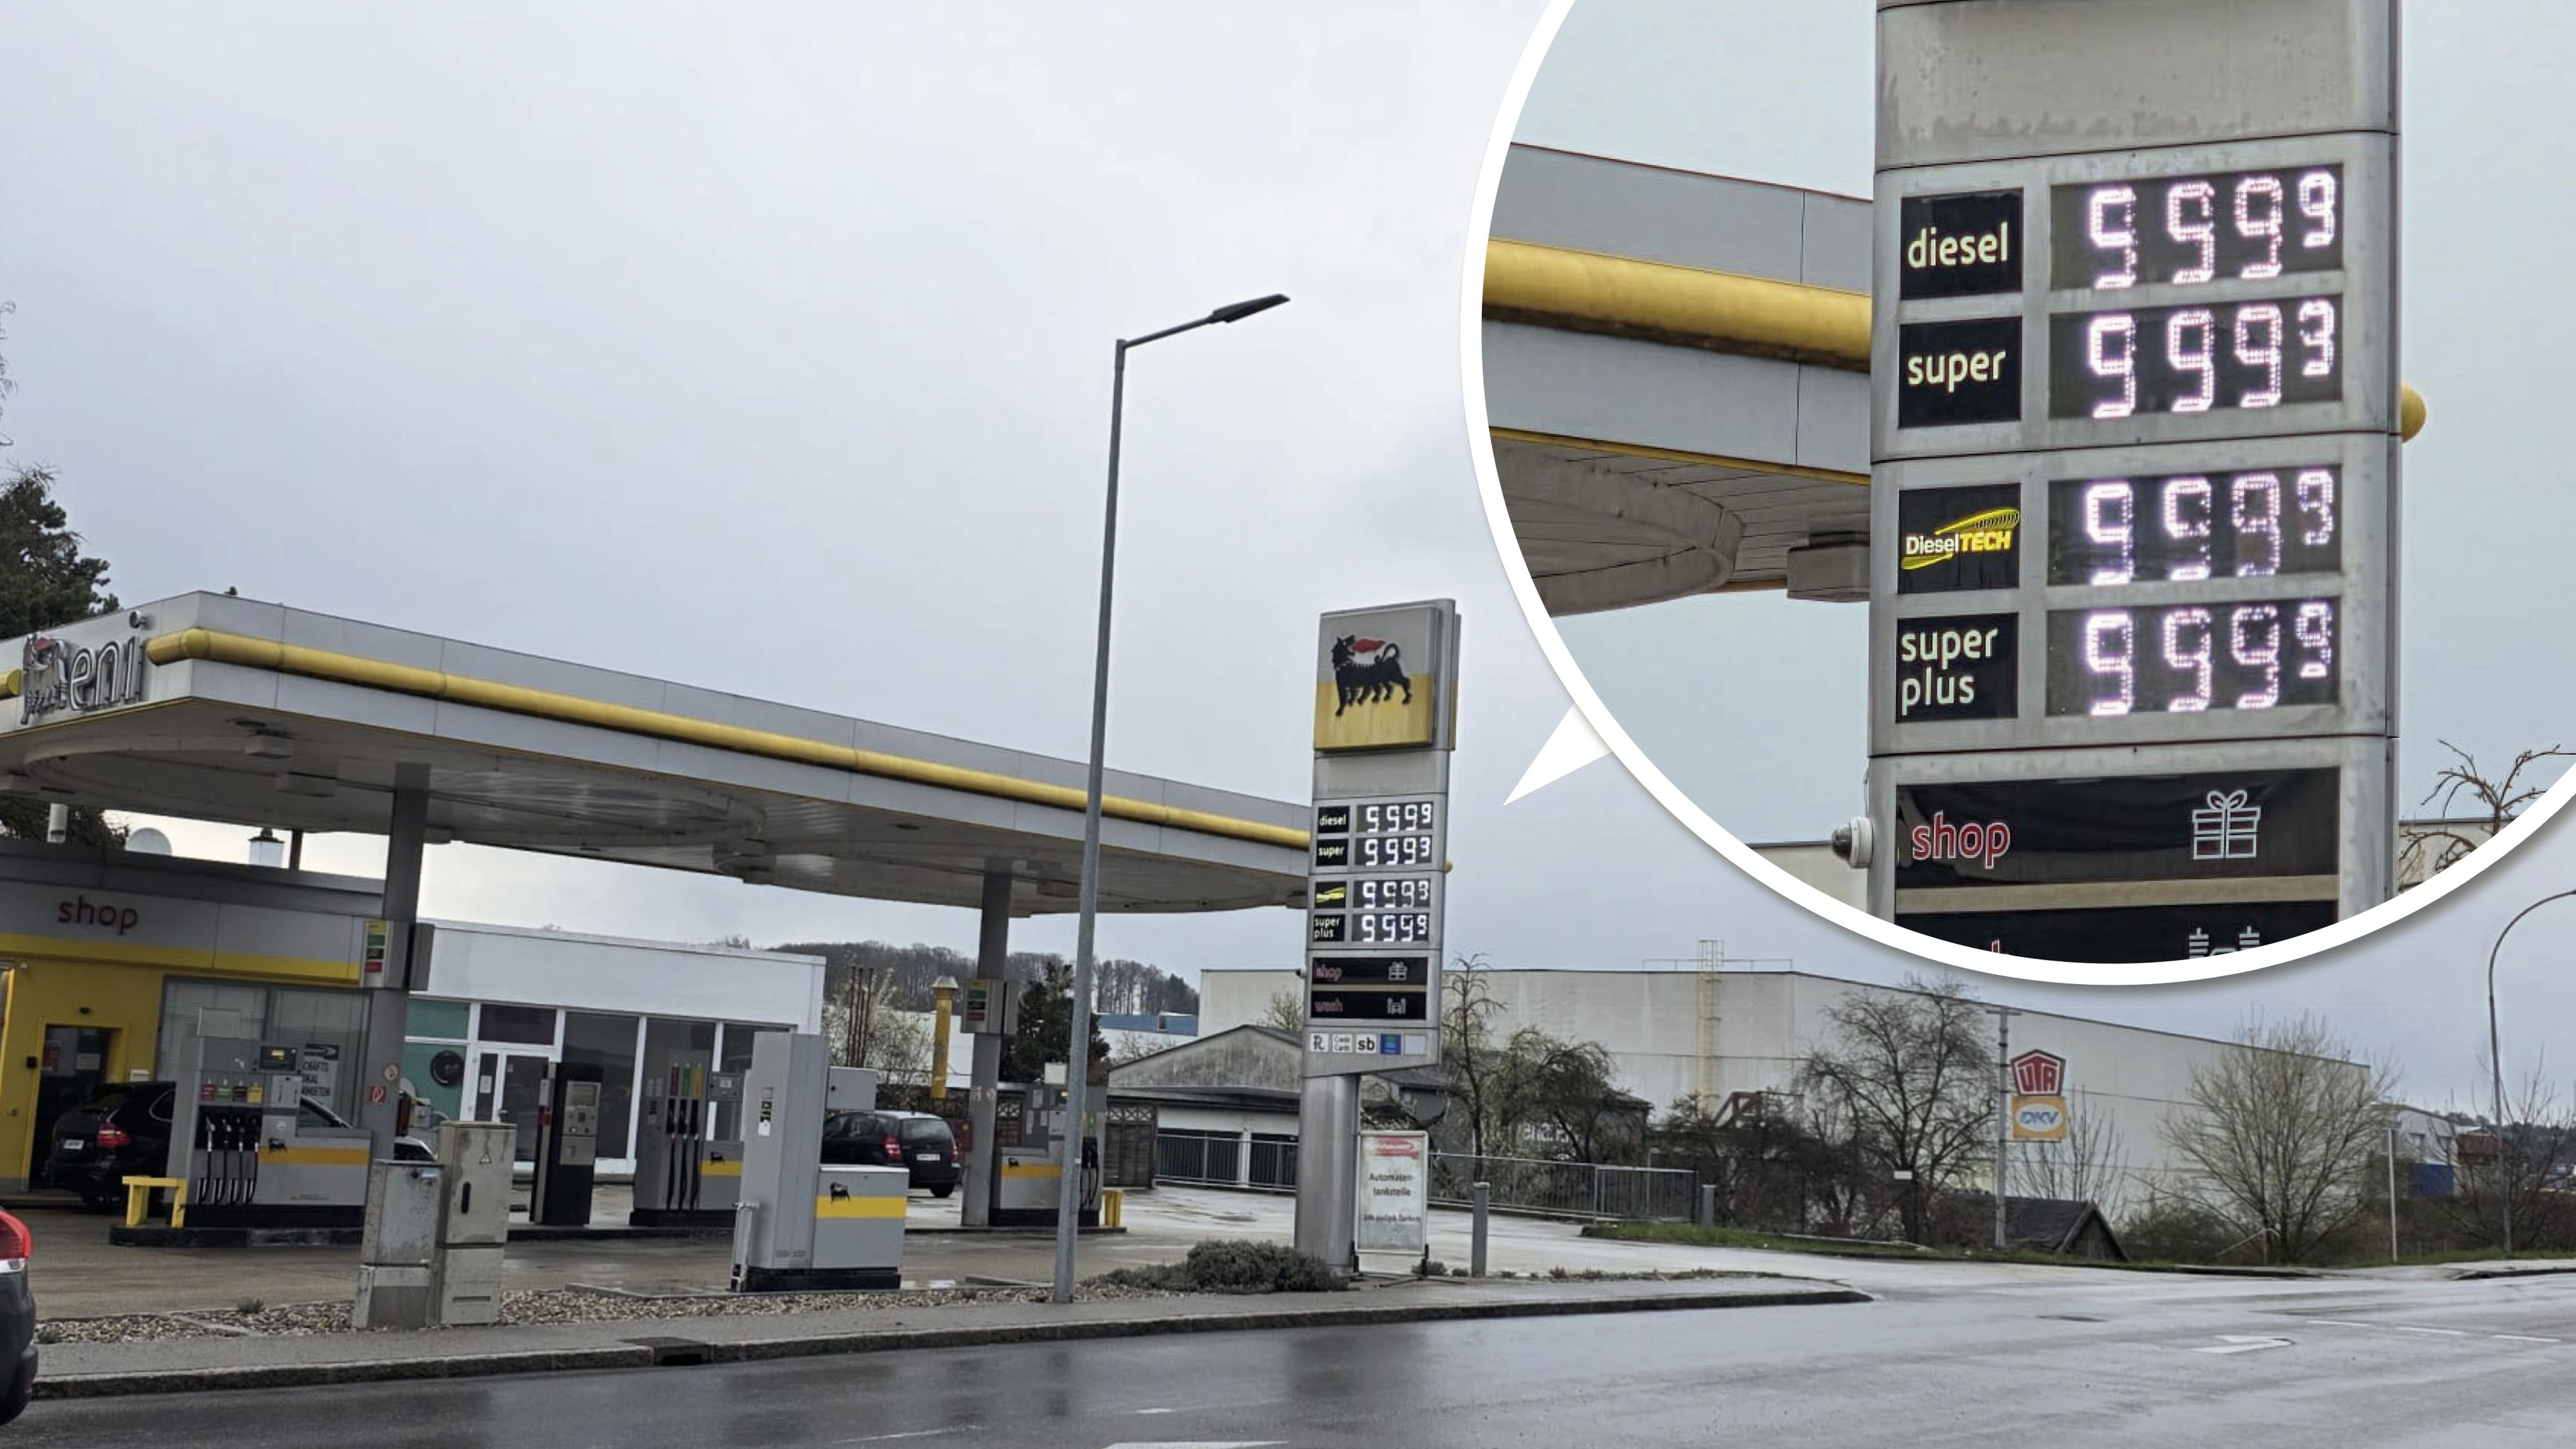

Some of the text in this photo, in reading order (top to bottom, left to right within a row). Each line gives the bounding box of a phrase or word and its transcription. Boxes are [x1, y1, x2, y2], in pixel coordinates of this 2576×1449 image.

[1908, 222, 2009, 269] diesel
[1908, 350, 2006, 392] super
[1906, 531, 2011, 555] DieselTECH
[70, 610, 143, 712] eni
[1901, 628, 1998, 670] super
[1902, 667, 1975, 716] plus
[1320, 815, 1347, 826] diesel
[1318, 846, 1345, 858] super
[1912, 810, 2011, 869] shop
[59, 895, 138, 935] shop
[1314, 918, 1340, 929] super
[1314, 927, 1334, 938] plus
[1316, 964, 1342, 981] shop
[1358, 1037, 1375, 1051] sb
[2018, 1056, 2059, 1092] UTA
[2020, 1112, 2059, 1124] DKV
